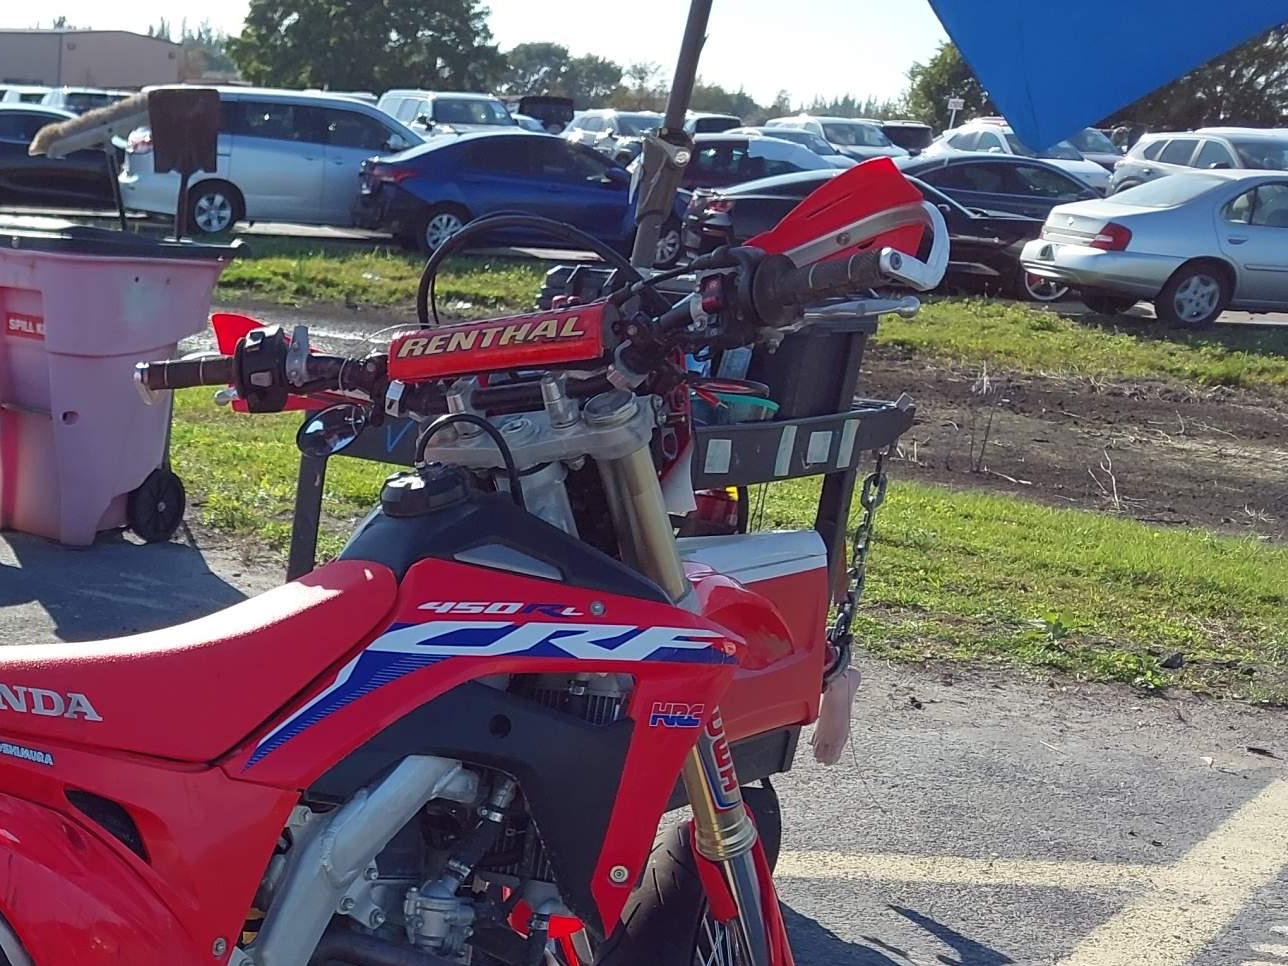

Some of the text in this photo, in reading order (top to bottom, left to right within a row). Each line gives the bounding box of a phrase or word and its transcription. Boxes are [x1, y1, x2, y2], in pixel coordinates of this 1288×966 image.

[397, 316, 585, 358] RENTHAL
[367, 620, 727, 662] CRF
[649, 702, 705, 728] HRC
